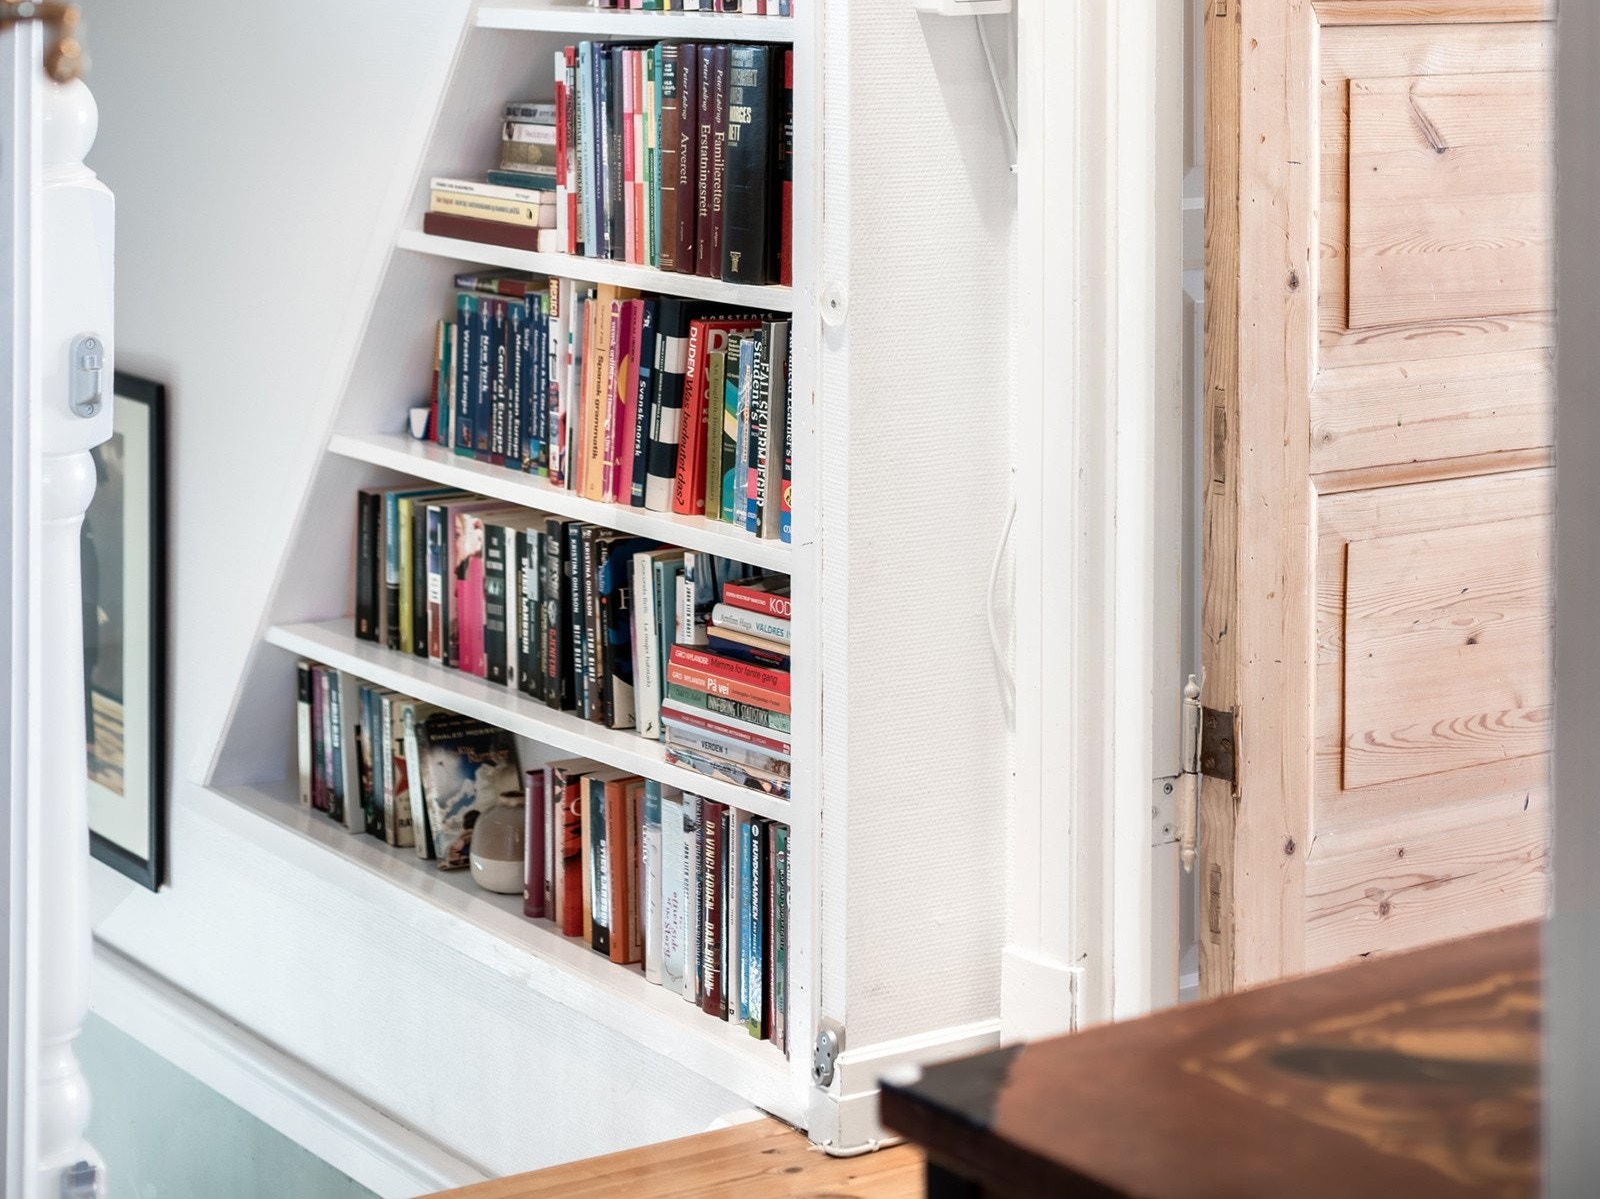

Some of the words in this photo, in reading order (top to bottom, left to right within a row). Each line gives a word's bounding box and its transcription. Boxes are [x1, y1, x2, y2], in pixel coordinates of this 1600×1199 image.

[680, 132, 689, 185] Arverett
[698, 123, 710, 217] Erstatningsrett
[712, 130, 724, 211] Familieretten
[686, 326, 697, 377] DUDEN
[595, 355, 604, 396] Spansk
[749, 340, 763, 421] Student's
[683, 380, 693, 410] Was
[495, 401, 504, 453] Europe
[591, 397, 601, 460] grammatik
[633, 380, 647, 457] Svensk-norsk
[785, 397, 793, 457] Learner's
[678, 411, 690, 471] bedeutet
[675, 473, 686, 505] das?
[547, 535, 559, 555] JO
[570, 538, 578, 574] KRISTINA
[583, 541, 591, 577] KRISTINA
[600, 546, 608, 566] High
[597, 564, 607, 593] Fidelity
[586, 627, 594, 654] LOTUS
[753, 622, 784, 636] VALDRES
[548, 628, 556, 678] GJENFERD
[573, 647, 581, 674] BLUES
[686, 652, 710, 665] NYLANDER
[708, 657, 735, 672] Mamma
[743, 667, 762, 679] første
[760, 673, 779, 685] gang
[683, 674, 706, 686] NYLANDER
[705, 677, 719, 691] På
[716, 681, 732, 695] vei
[699, 740, 724, 753] VERDEN
[705, 820, 714, 835] DA
[705, 837, 714, 910] VINCI-KODEN
[663, 921, 671, 958] Story
[704, 921, 714, 945] DAN
[703, 948, 714, 990] BROWN
